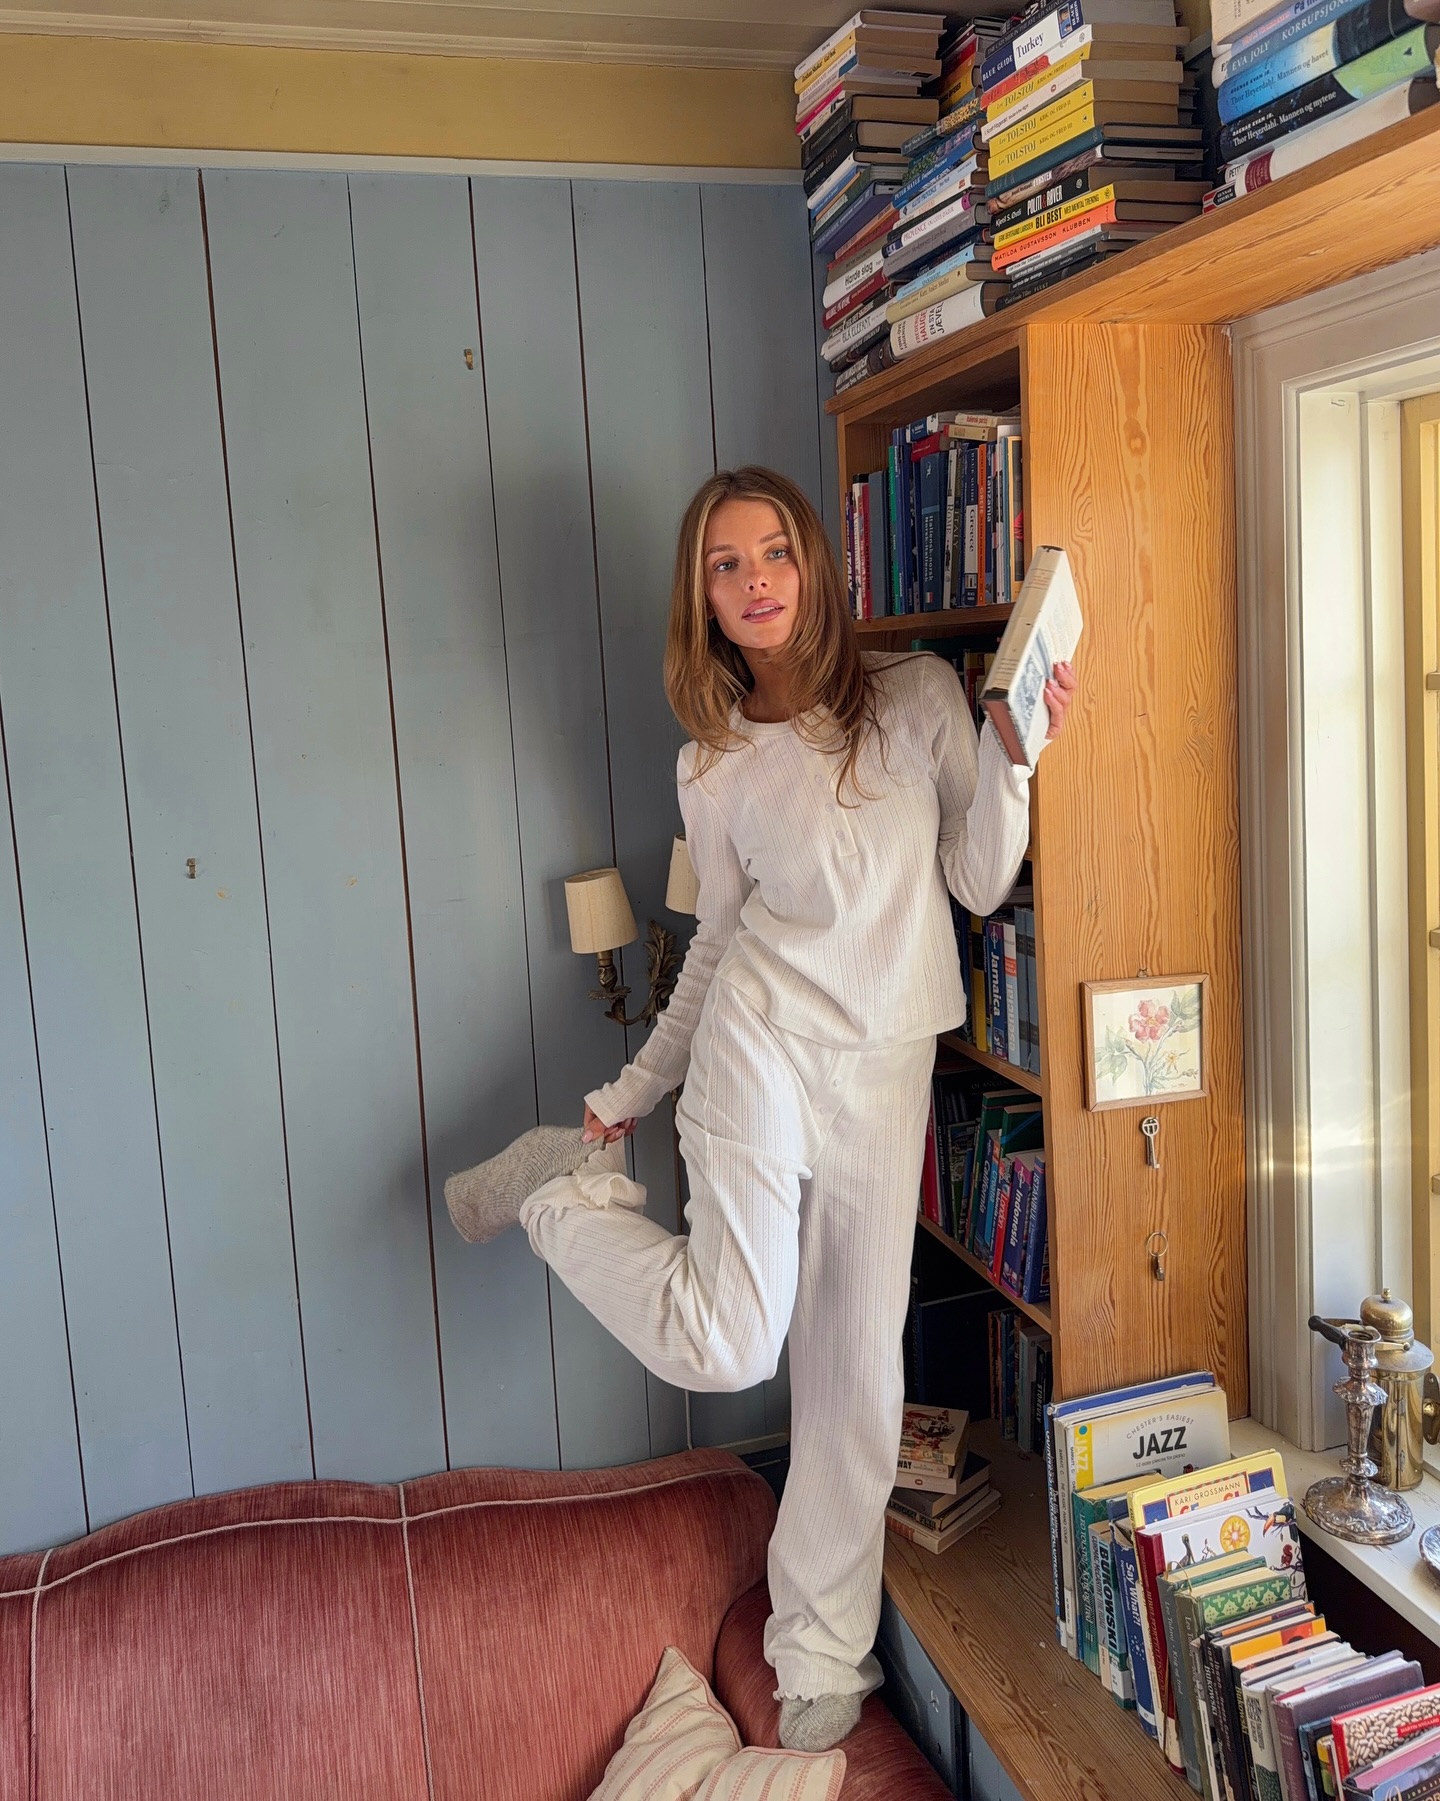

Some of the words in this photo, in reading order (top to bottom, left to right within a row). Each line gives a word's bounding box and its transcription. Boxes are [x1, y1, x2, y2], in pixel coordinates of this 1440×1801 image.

[982, 67, 996, 81] BLUE
[996, 54, 1013, 70] GUIDE
[1016, 33, 1044, 58] Turkey
[1231, 56, 1248, 71] EVA
[1250, 41, 1270, 61] JOLY
[1230, 92, 1244, 105] Thor
[1277, 64, 1302, 82] Mannen
[1302, 60, 1311, 68] og
[1311, 50, 1329, 63] havet
[1005, 82, 1034, 106] TOLSTOJ
[1006, 118, 1037, 142] TOLSTOJ
[1232, 134, 1247, 147] Thor
[1248, 120, 1279, 140] Heyerdahl.
[1278, 108, 1304, 124] Mannen
[1304, 104, 1313, 112] og
[1313, 90, 1336, 107] mytene
[1232, 123, 1252, 136] RAGNAR
[1252, 116, 1266, 127] KVAM
[1006, 140, 1037, 164] TOLSTOJ
[1027, 195, 1042, 216] POLITI
[1036, 214, 1046, 229] BLI
[1046, 207, 1062, 225] BEST
[903, 222, 926, 242] PROVENCE
[994, 248, 1018, 262] MATILDA
[1020, 232, 1057, 251] GUSTAVSSON
[1062, 218, 1091, 233] KLUBBEN
[844, 270, 861, 286] Harde
[862, 262, 874, 275] slag
[920, 310, 928, 342] HAUGE
[928, 308, 936, 324] STA
[928, 325, 936, 335] EN
[936, 302, 945, 334] JÆVEL
[946, 504, 954, 538] ROME
[991, 954, 1002, 1017] Jamaica
[980, 1160, 990, 1214] California
[1030, 1172, 1040, 1221] ISTANBUL
[998, 1192, 1008, 1229] London
[1010, 1188, 1023, 1247] Indonesia
[1126, 1415, 1163, 1440] CHESTER'S
[1166, 1414, 1194, 1425] EASIEST
[1132, 1426, 1188, 1460] JAZZ
[1046, 1430, 1054, 1483] GUINNESS
[1075, 1437, 1088, 1472] JAZZ
[1152, 1458, 1166, 1466] pieces
[1172, 1453, 1186, 1462] piano
[1174, 1496, 1192, 1506] KARI
[1194, 1482, 1241, 1501] GROSSMANN
[1094, 1561, 1102, 1596] McCARTHY
[1126, 1562, 1135, 1585] Say
[1100, 1546, 1117, 1650] BUKOWSKI
[1130, 1587, 1142, 1627] What?!
[1214, 1660, 1222, 1688] Ibsen
[1204, 1665, 1218, 1716] Bukowski
[1236, 1686, 1248, 1735] Bukowski
[1400, 1723, 1418, 1733] MARTIN
[1418, 1718, 1440, 1728] NYGAARD
[1407, 1786, 1427, 1799] JOHN
